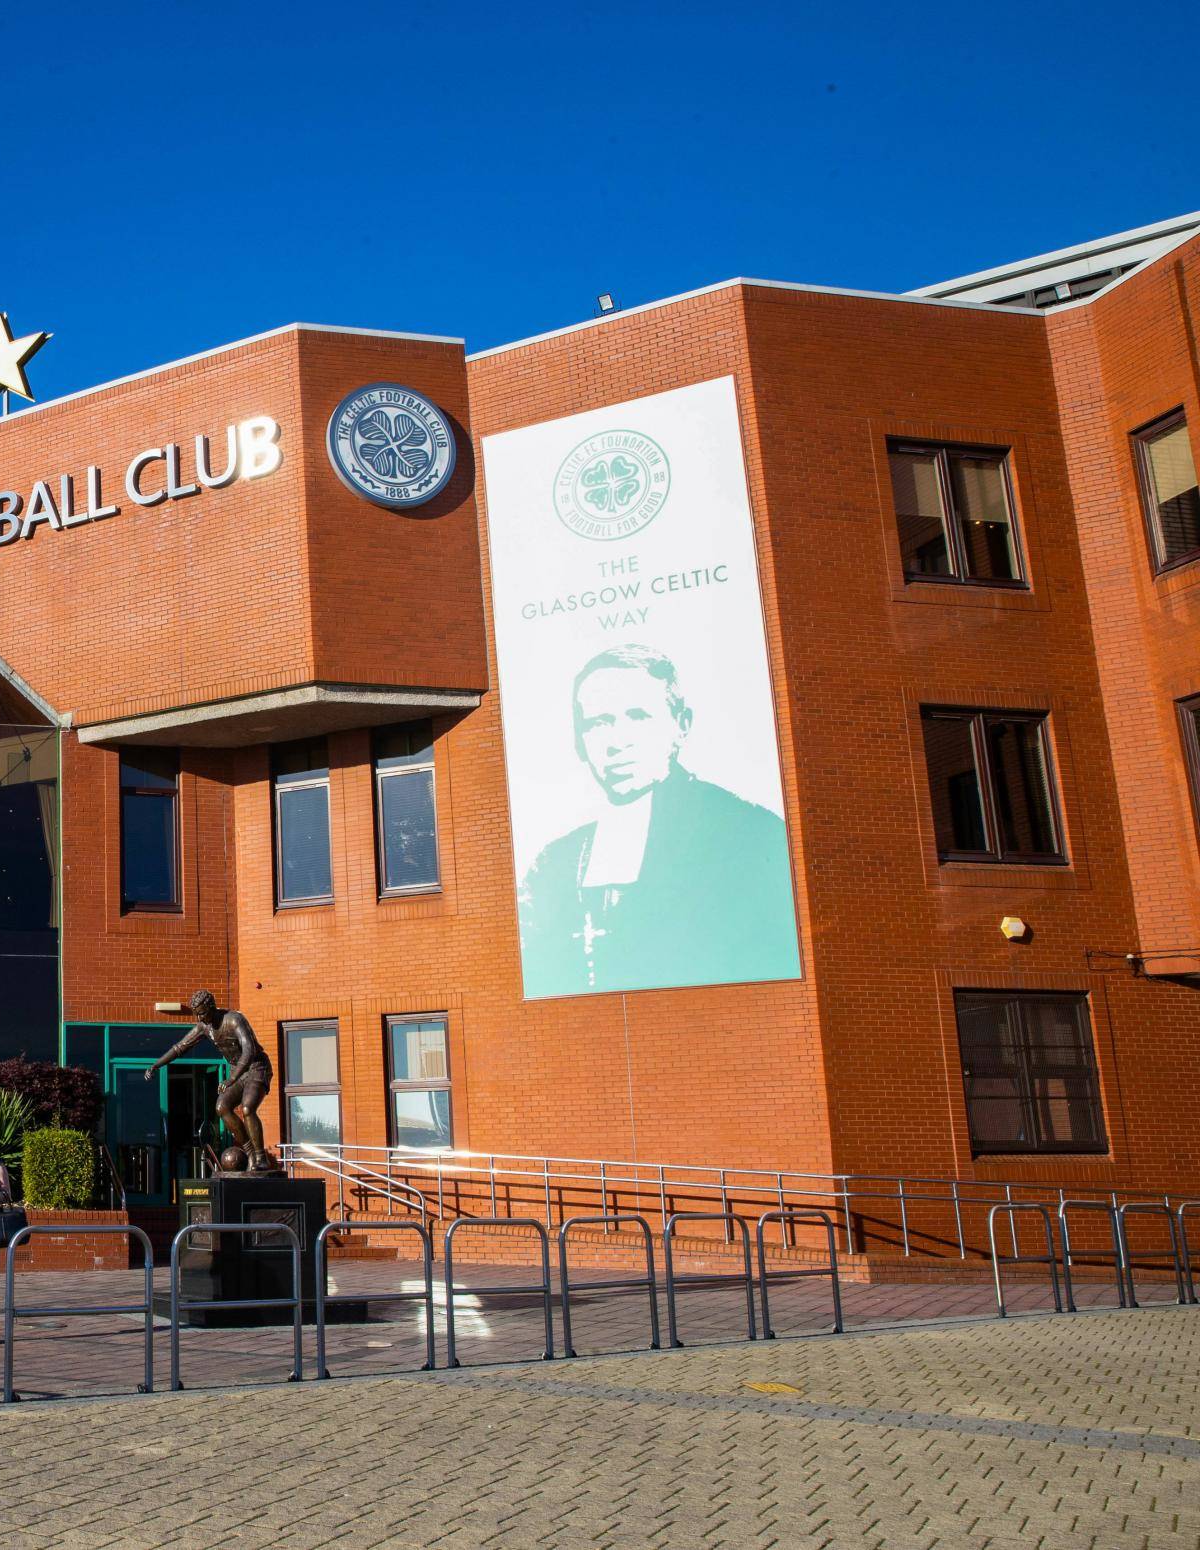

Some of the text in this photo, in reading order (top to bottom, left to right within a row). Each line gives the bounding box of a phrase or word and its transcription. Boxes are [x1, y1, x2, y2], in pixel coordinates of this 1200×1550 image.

[338, 391, 448, 448] THE CELTIC FOOTBALL CLUB
[125, 415, 283, 507] CLUB
[560, 435, 662, 487] CELTIC FC FOUNDATION
[384, 486, 411, 499] 1888
[564, 491, 664, 537] FOOTBALL FOR GOOD
[597, 555, 640, 578] THE
[521, 565, 729, 620] GLASGOW CELTIC
[598, 606, 650, 631] WAY
